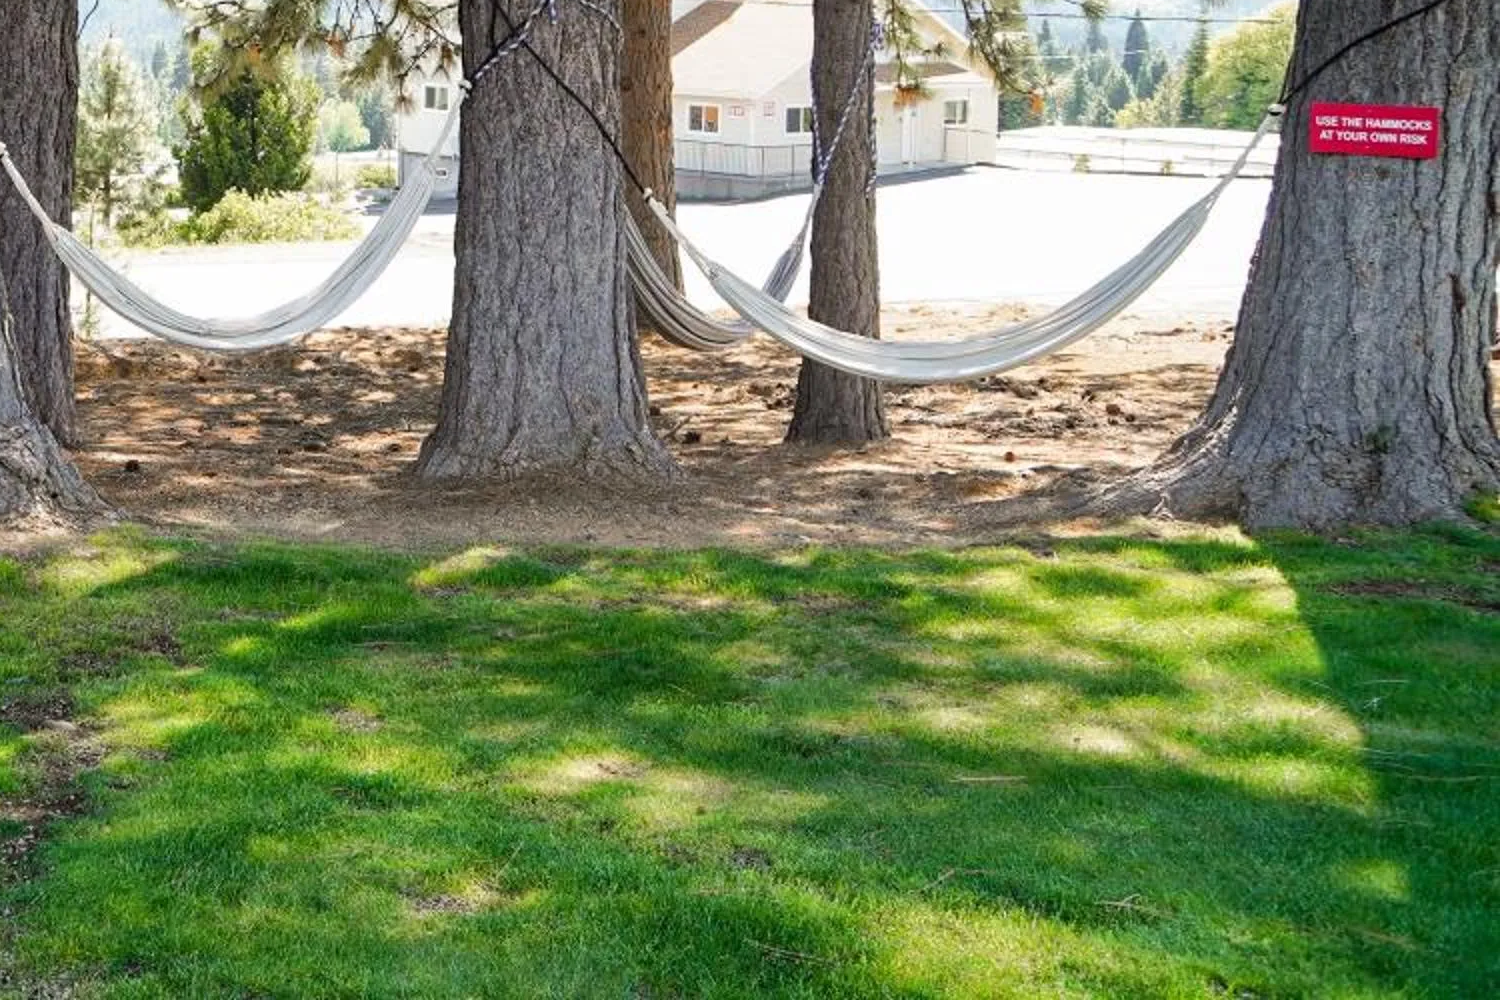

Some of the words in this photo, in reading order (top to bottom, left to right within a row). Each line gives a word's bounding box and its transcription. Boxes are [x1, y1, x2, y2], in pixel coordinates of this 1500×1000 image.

[1315, 116, 1338, 126] USE
[1341, 117, 1363, 128] THE
[1365, 118, 1433, 131] HAMMOCKS
[1320, 130, 1334, 140] AT
[1336, 131, 1368, 142] YOUR
[1369, 132, 1397, 143] OWN
[1399, 133, 1427, 145] RISK
